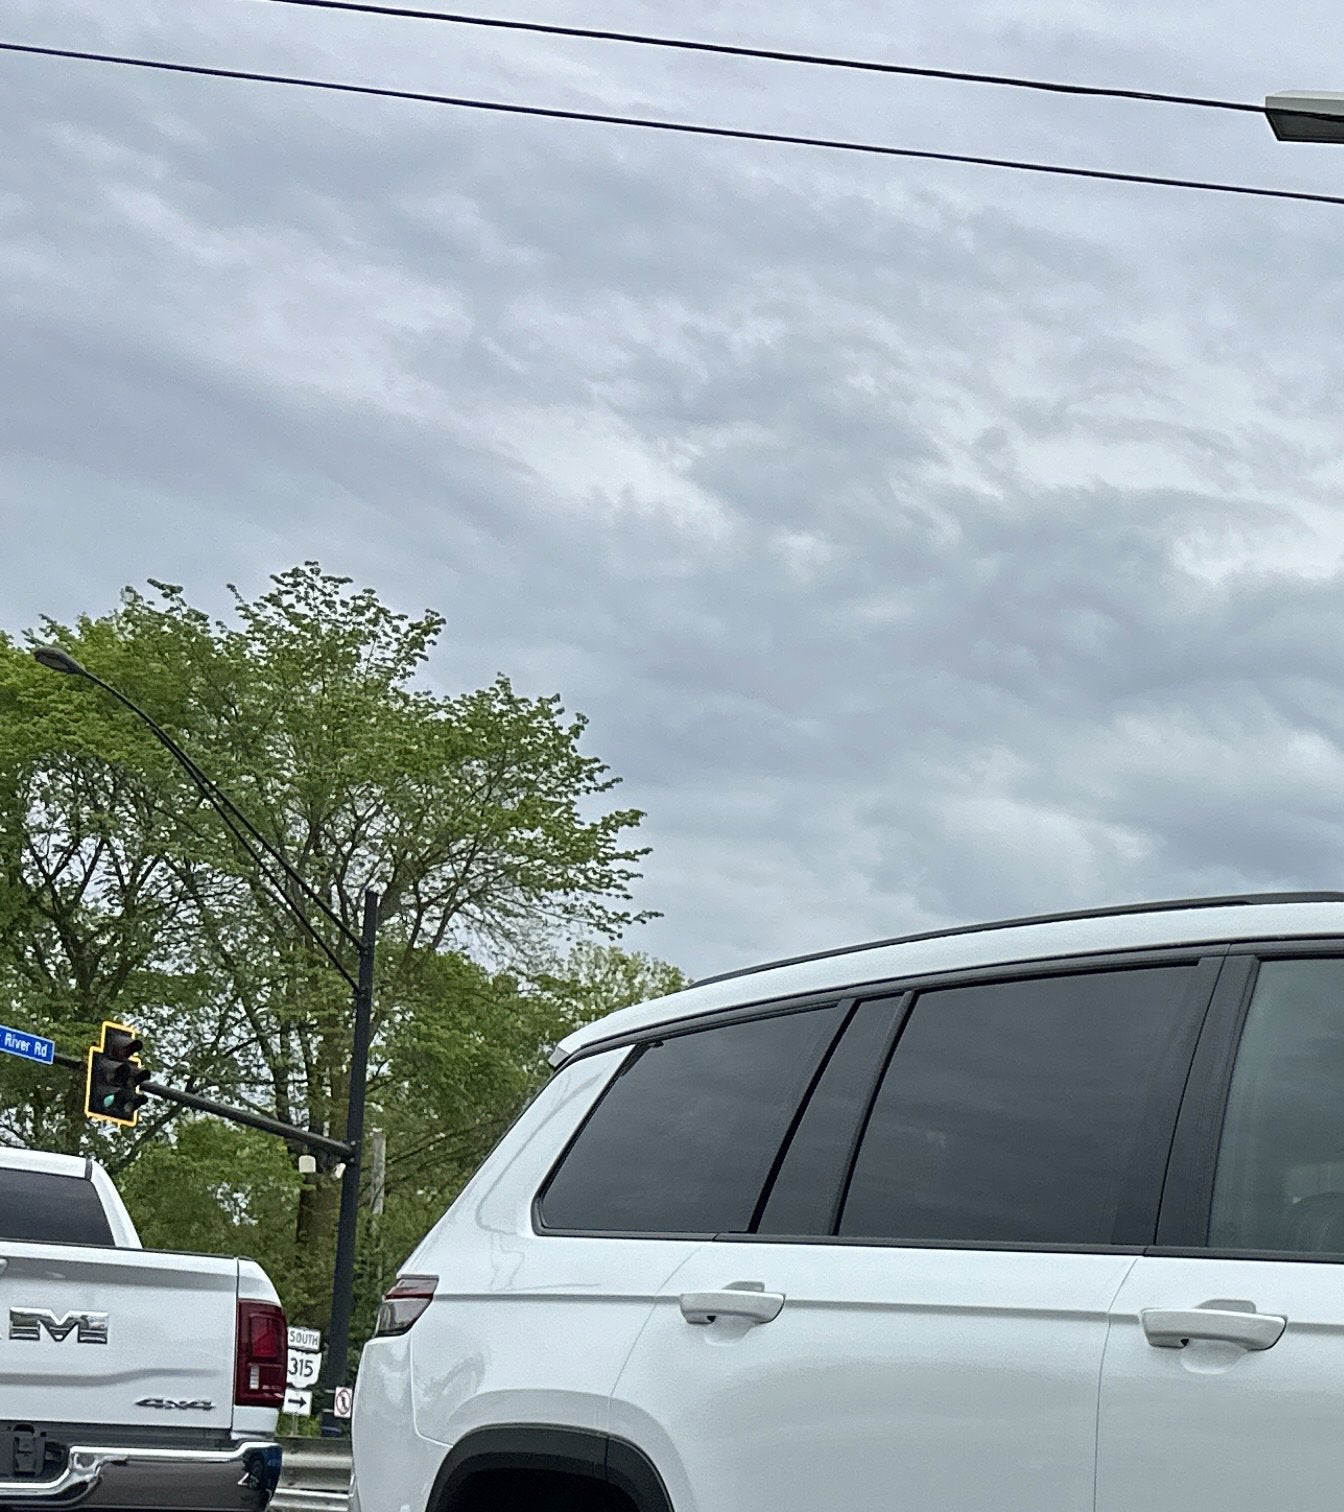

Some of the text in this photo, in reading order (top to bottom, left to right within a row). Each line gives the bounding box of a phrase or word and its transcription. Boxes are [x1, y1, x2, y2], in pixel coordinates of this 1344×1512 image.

[5, 1032, 48, 1057] River Rd
[289, 1330, 319, 1346] SOUTH
[288, 1357, 314, 1378] 315
